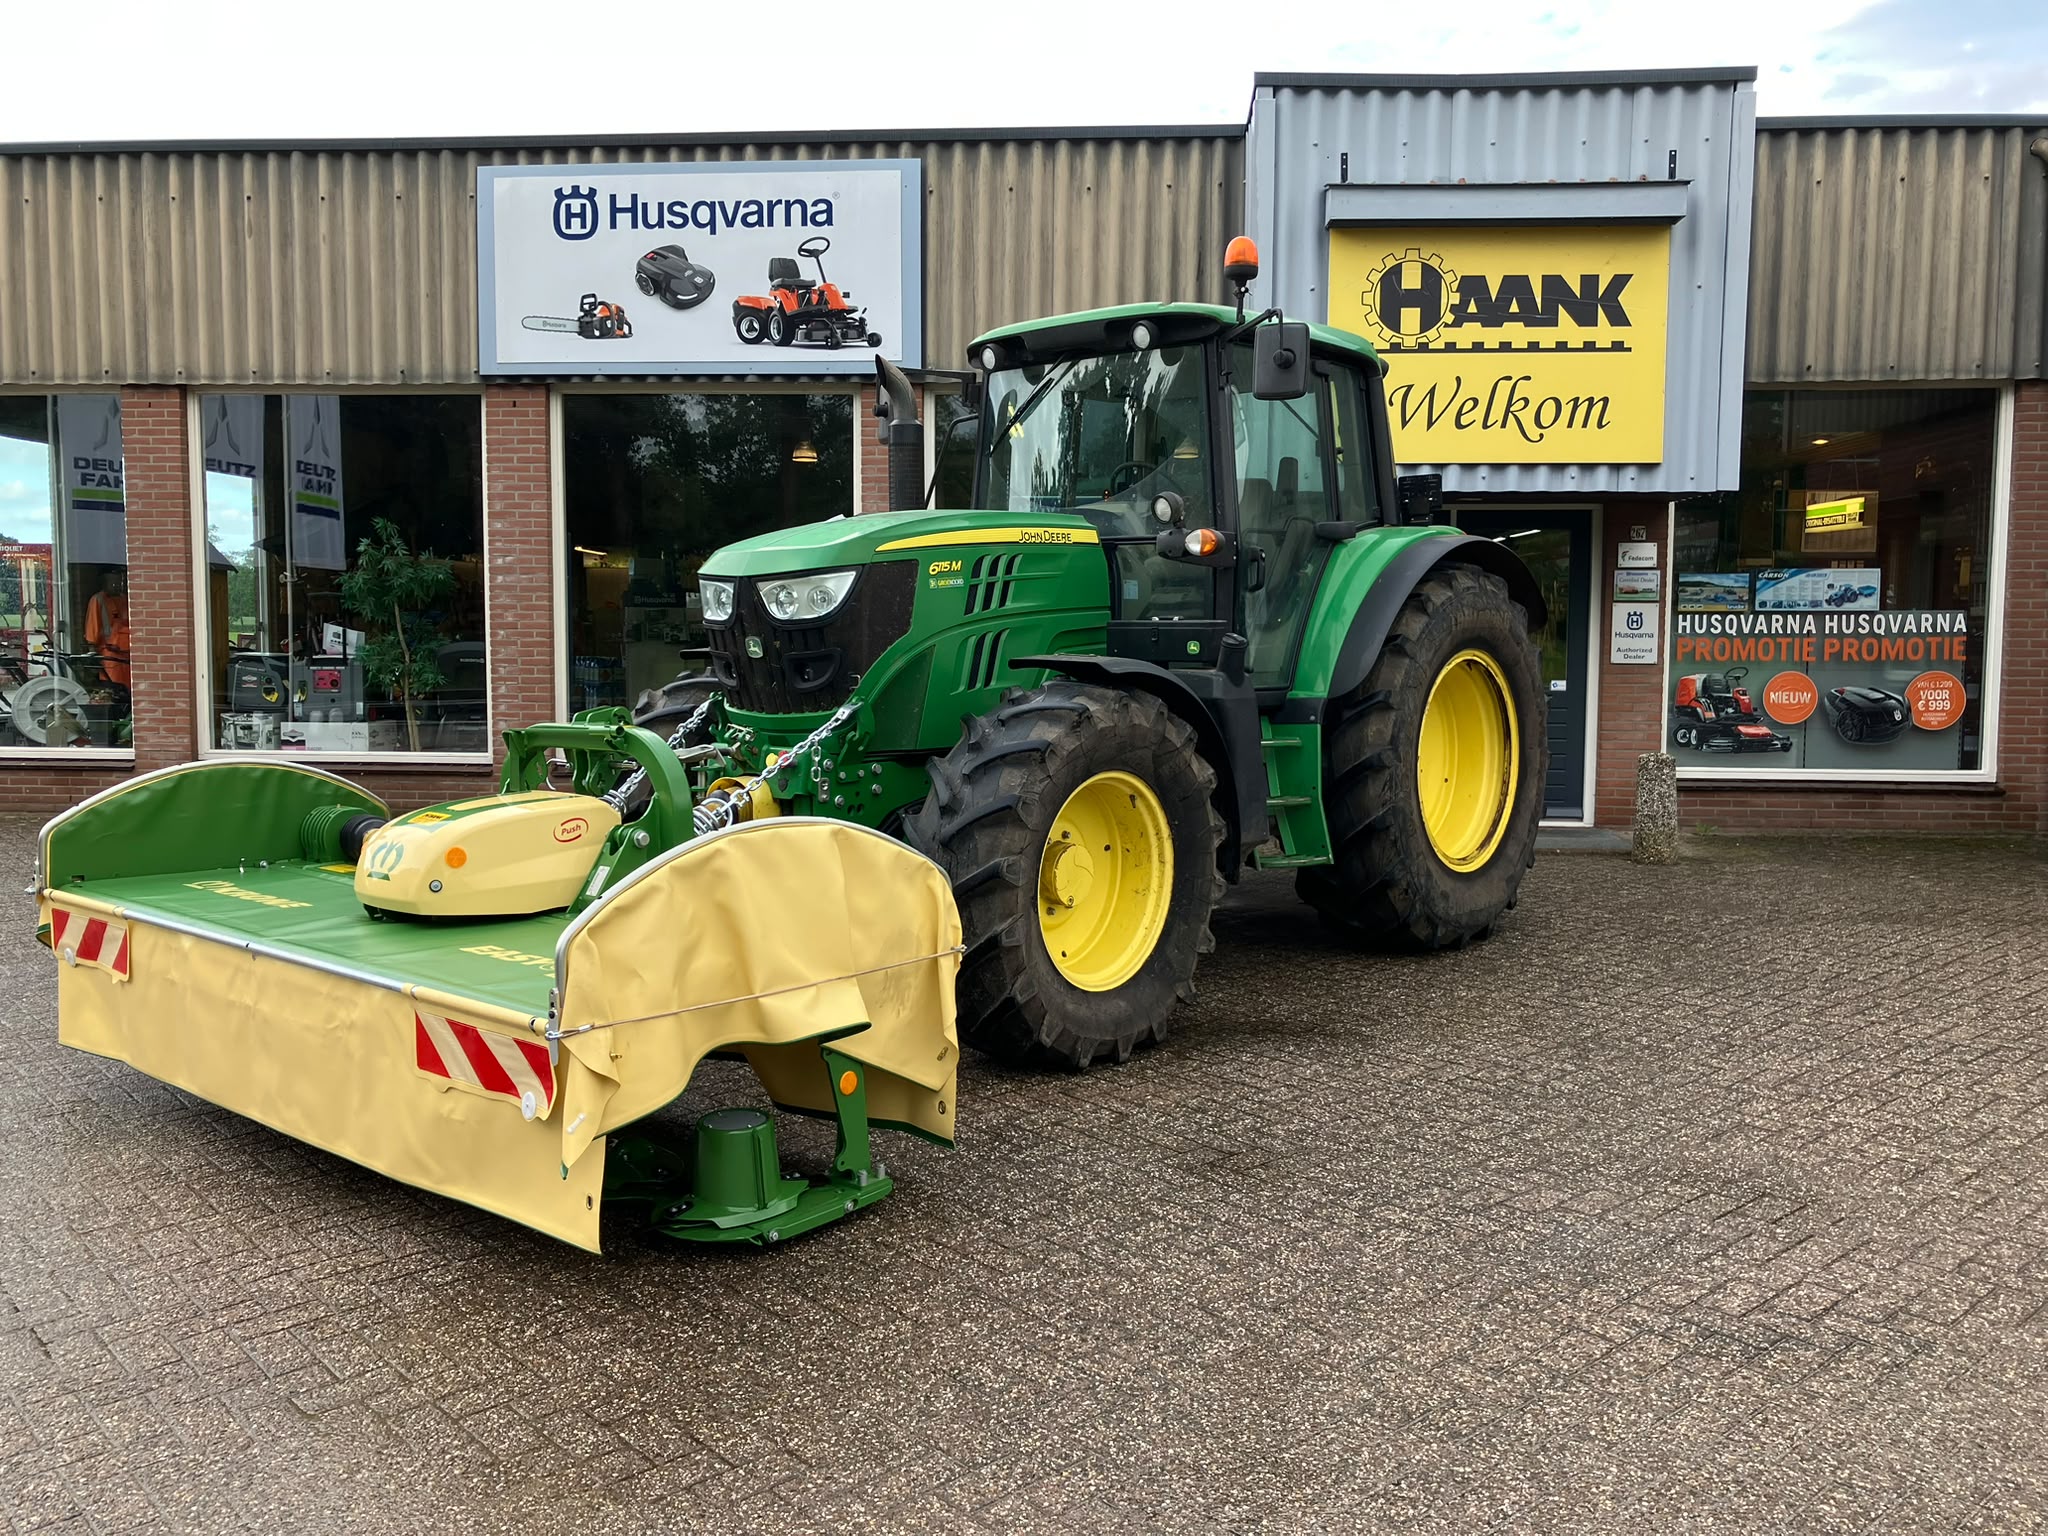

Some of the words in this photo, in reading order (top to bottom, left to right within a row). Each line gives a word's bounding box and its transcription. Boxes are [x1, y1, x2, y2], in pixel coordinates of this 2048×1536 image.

[608, 193, 835, 236] Husqvarna
[1379, 262, 1634, 335] HAANK
[1388, 375, 1611, 443] Welkom
[73, 457, 123, 473] DEU
[205, 458, 257, 478] EUTZ
[80, 472, 123, 489] FAH
[1678, 613, 1817, 635] HUSQVARNA
[1824, 612, 1968, 634] HUSQVARNA
[1614, 631, 1654, 639] Husqvarna
[1675, 636, 1816, 662] PROMOTIE
[1824, 636, 1967, 661] PROMOTIE
[1769, 690, 1811, 704] NIEUW
[1920, 689, 1950, 700] VOOR
[1917, 700, 1926, 711] €
[1928, 700, 1951, 711] 999
[561, 823, 581, 836] Push
